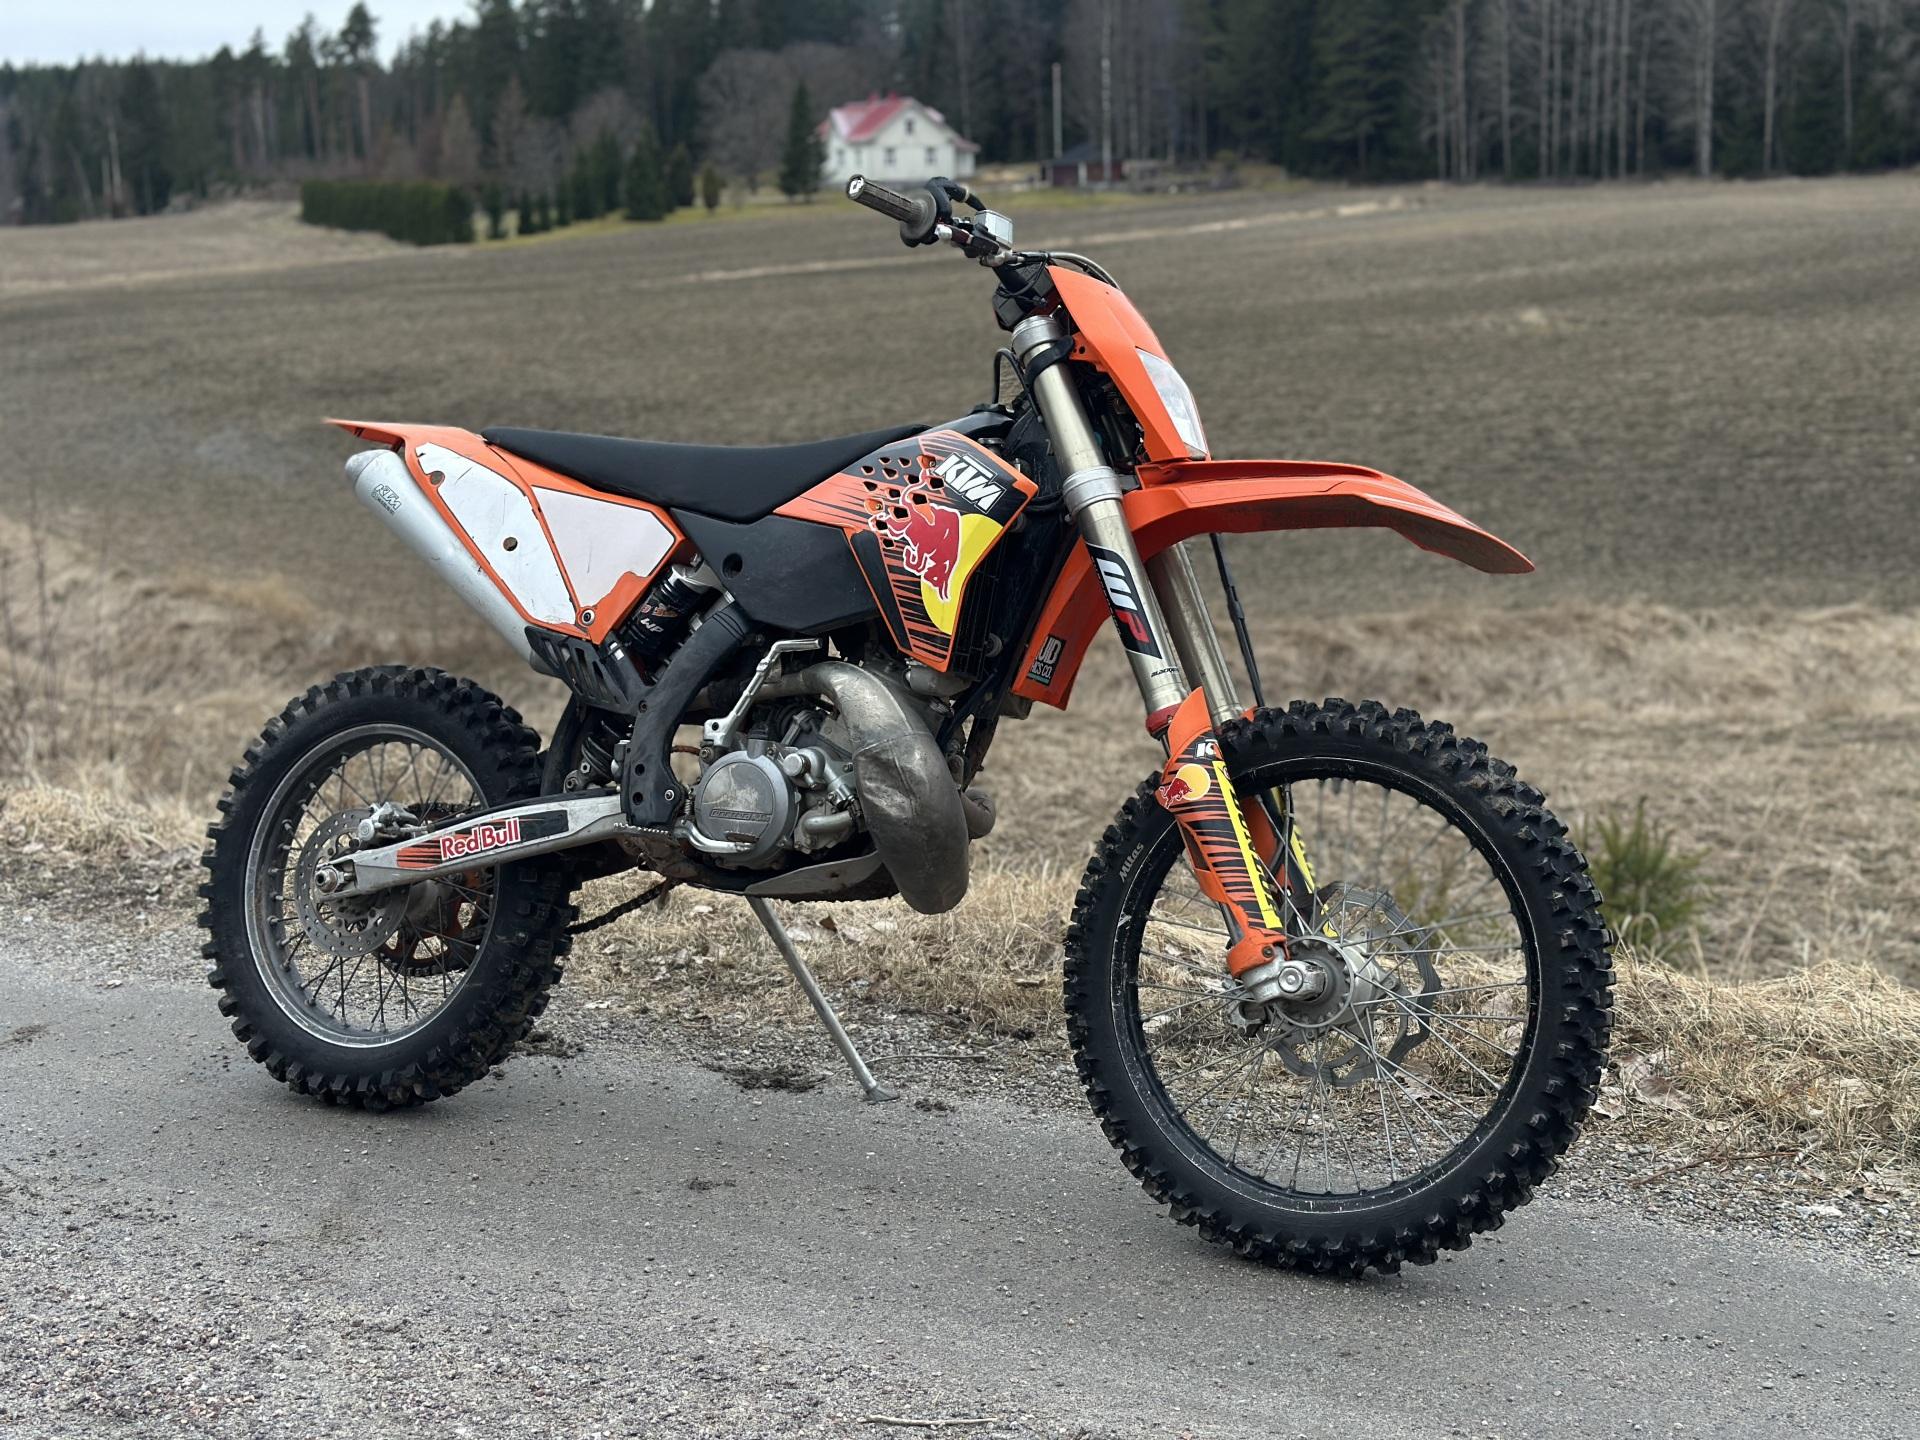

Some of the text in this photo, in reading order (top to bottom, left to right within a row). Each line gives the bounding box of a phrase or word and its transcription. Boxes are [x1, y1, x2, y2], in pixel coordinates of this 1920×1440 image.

[374, 484, 401, 510] KTM
[932, 452, 1006, 513] KTM
[1096, 558, 1150, 643] WP
[640, 618, 664, 632] WP
[1037, 637, 1062, 664] UID
[441, 818, 520, 860] Red Bull
[1119, 842, 1144, 883] Mitas
